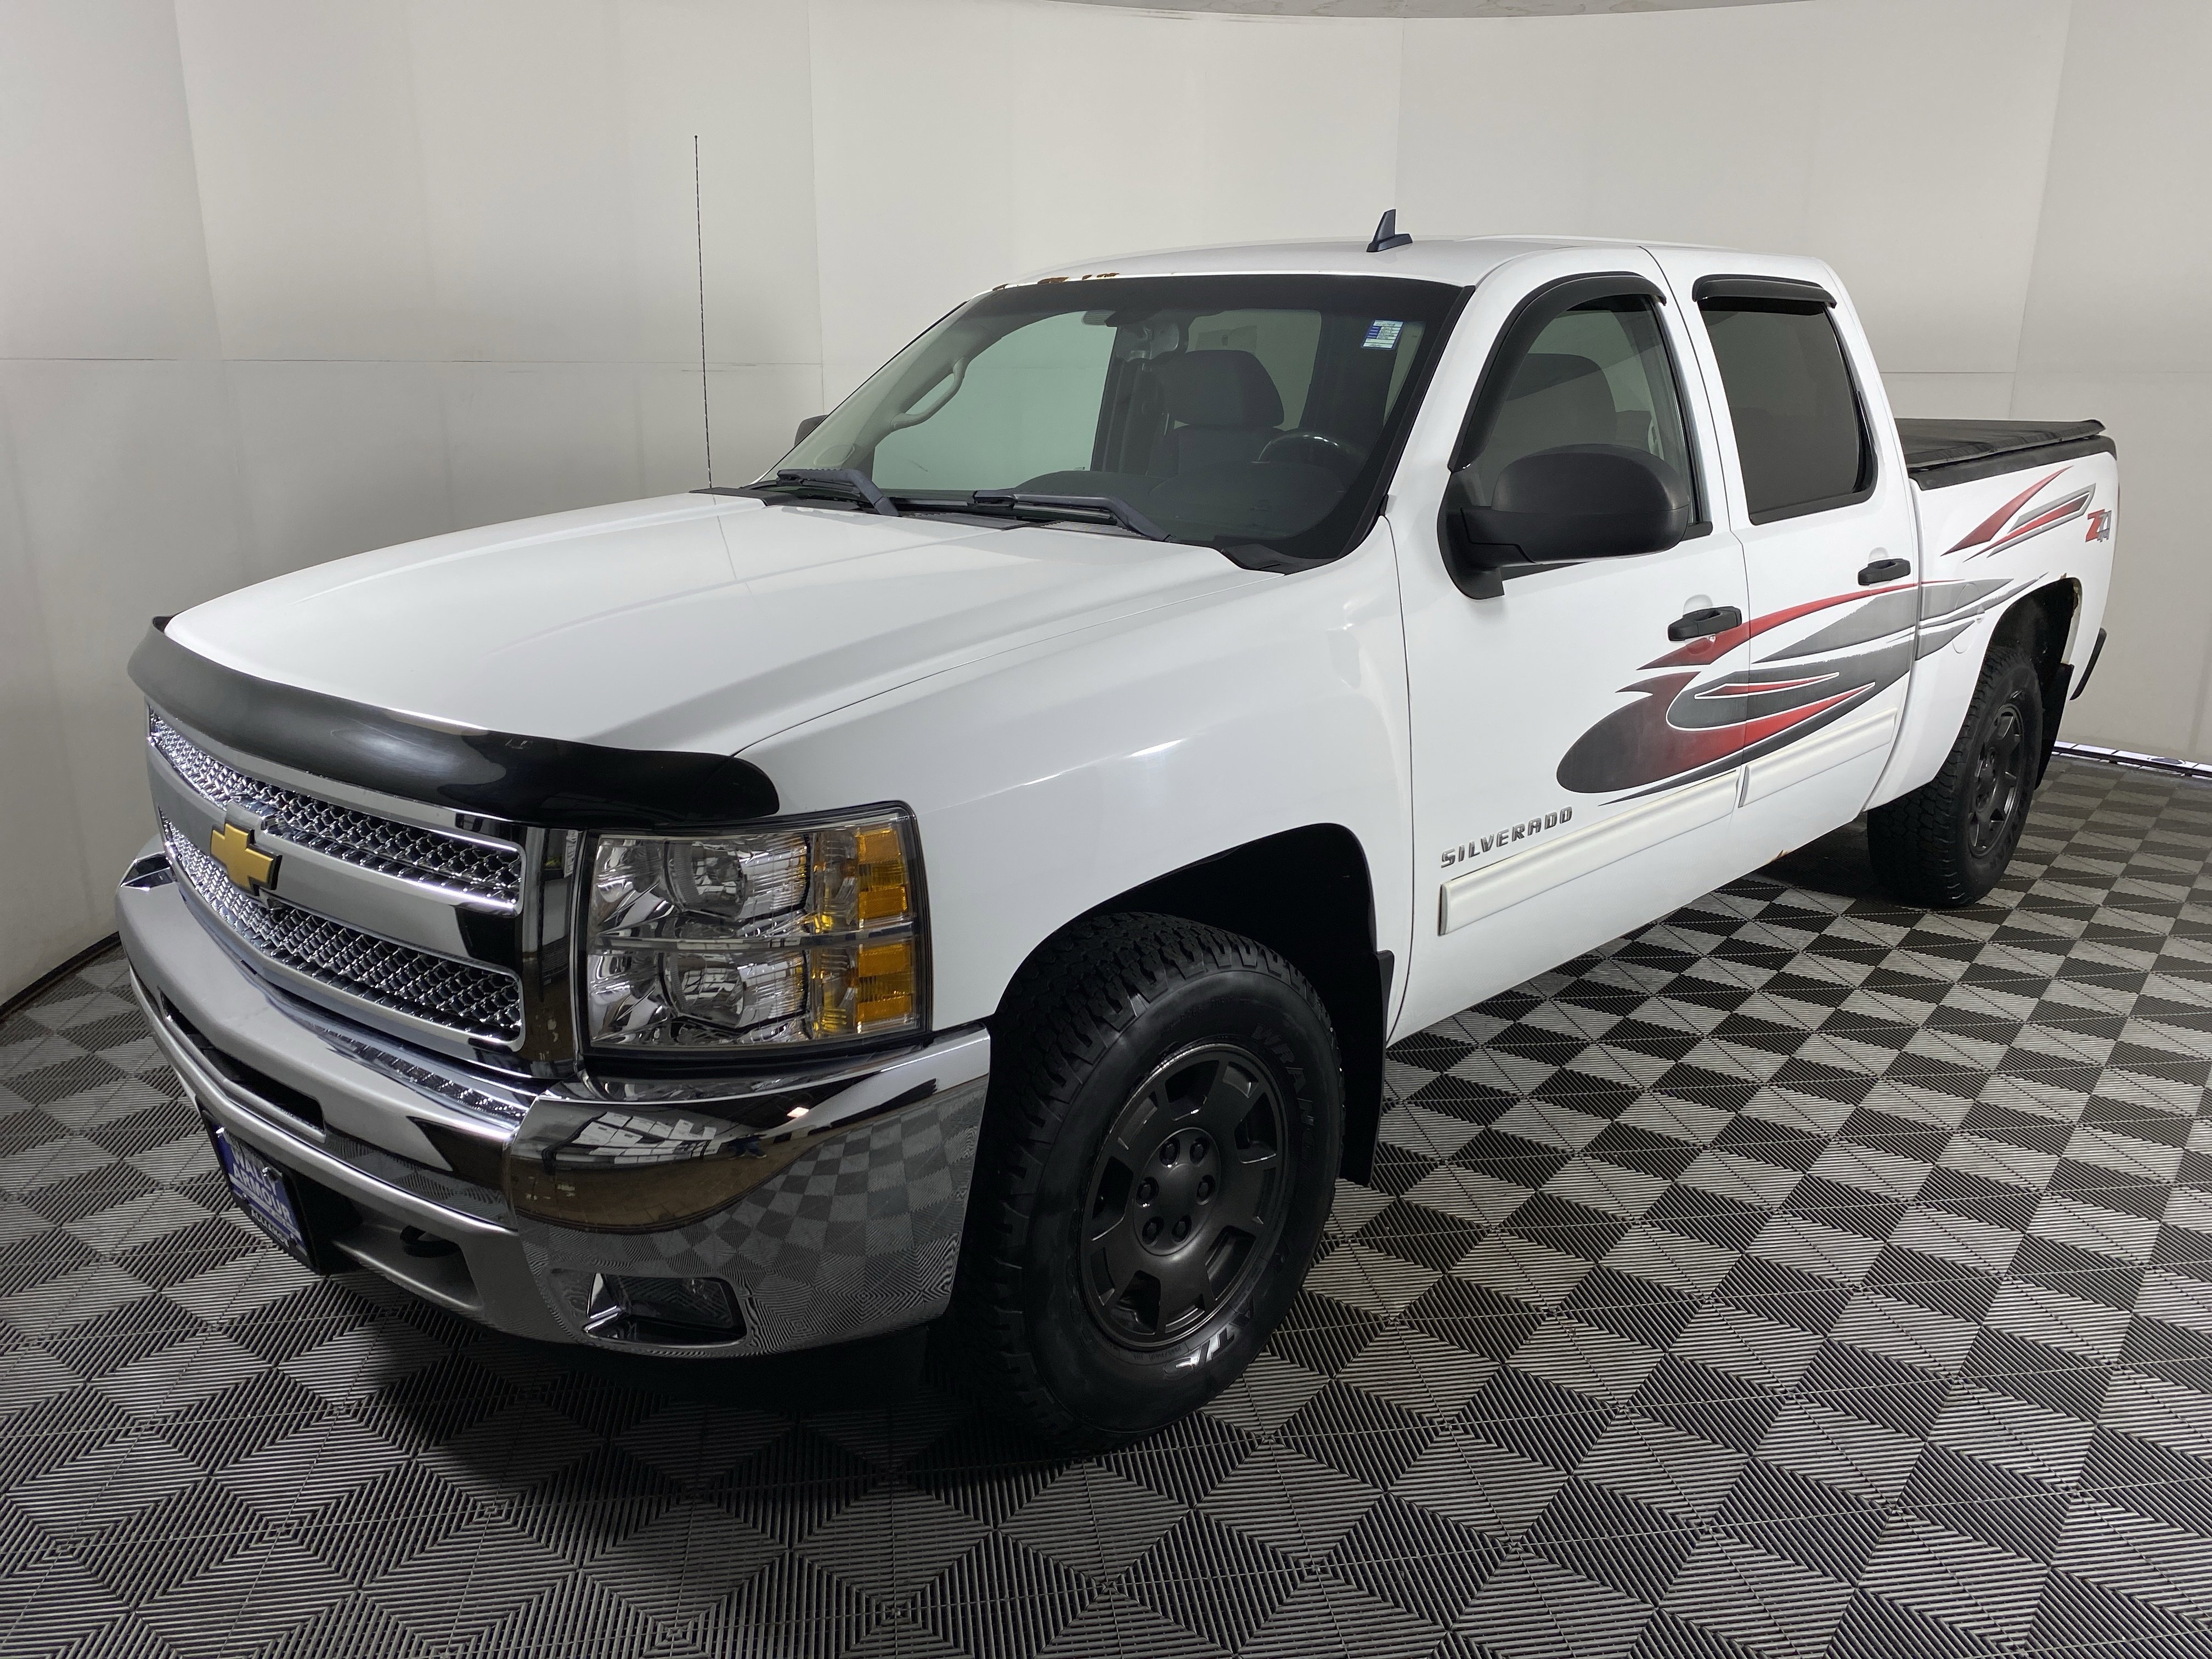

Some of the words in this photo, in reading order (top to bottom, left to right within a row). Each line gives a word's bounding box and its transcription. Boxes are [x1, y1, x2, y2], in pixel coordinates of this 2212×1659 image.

[1441, 806, 1572, 868] SILVERADO
[230, 1146, 276, 1196] WALLY
[233, 1163, 294, 1227] ARMOUR
